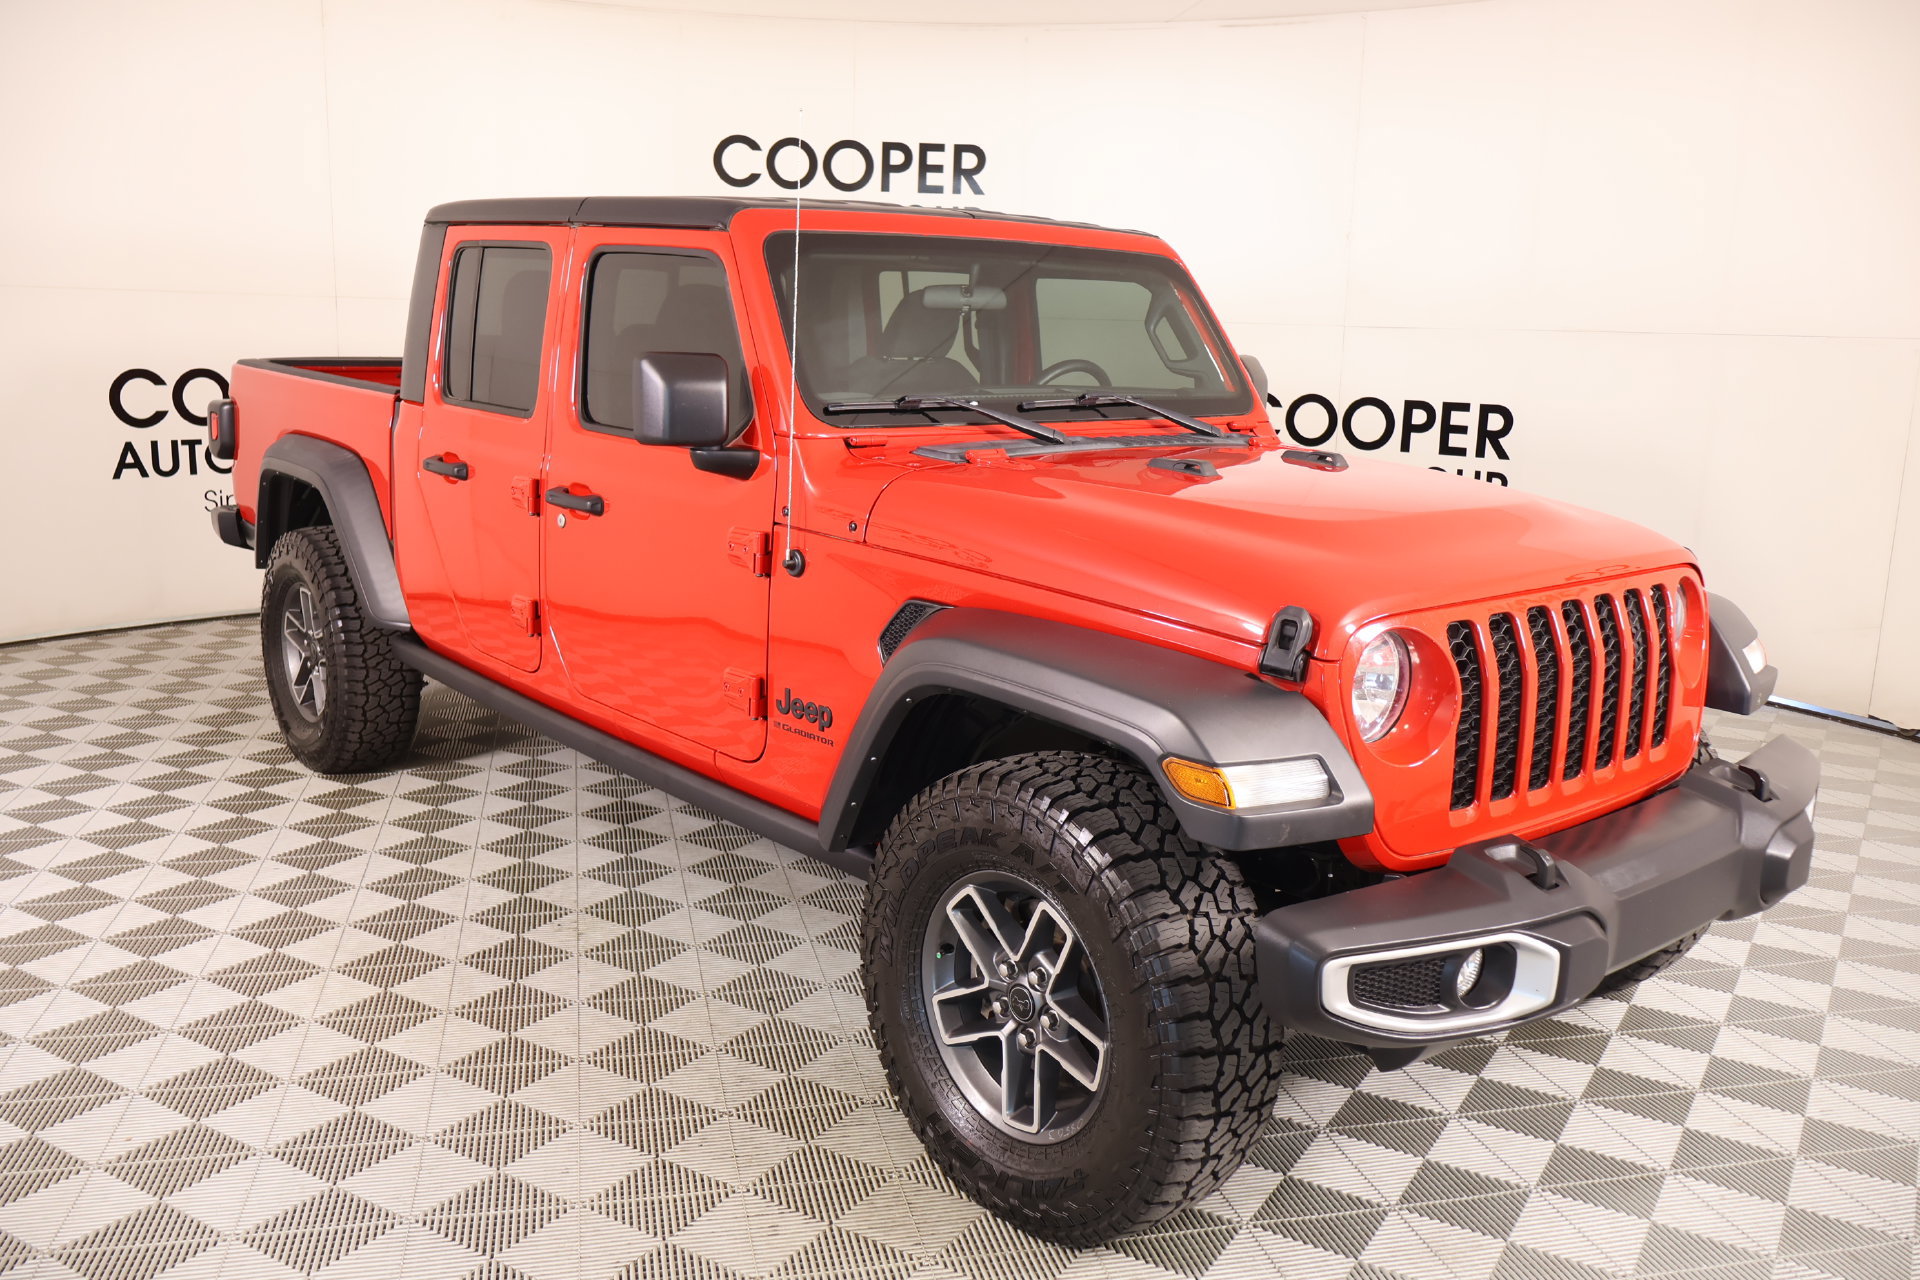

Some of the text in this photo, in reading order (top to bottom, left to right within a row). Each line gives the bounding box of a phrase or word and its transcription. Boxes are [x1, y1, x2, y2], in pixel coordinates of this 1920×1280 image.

[713, 134, 986, 195] COOPER
[776, 688, 833, 732] Jeep
[781, 723, 834, 747] GLADIATOR
